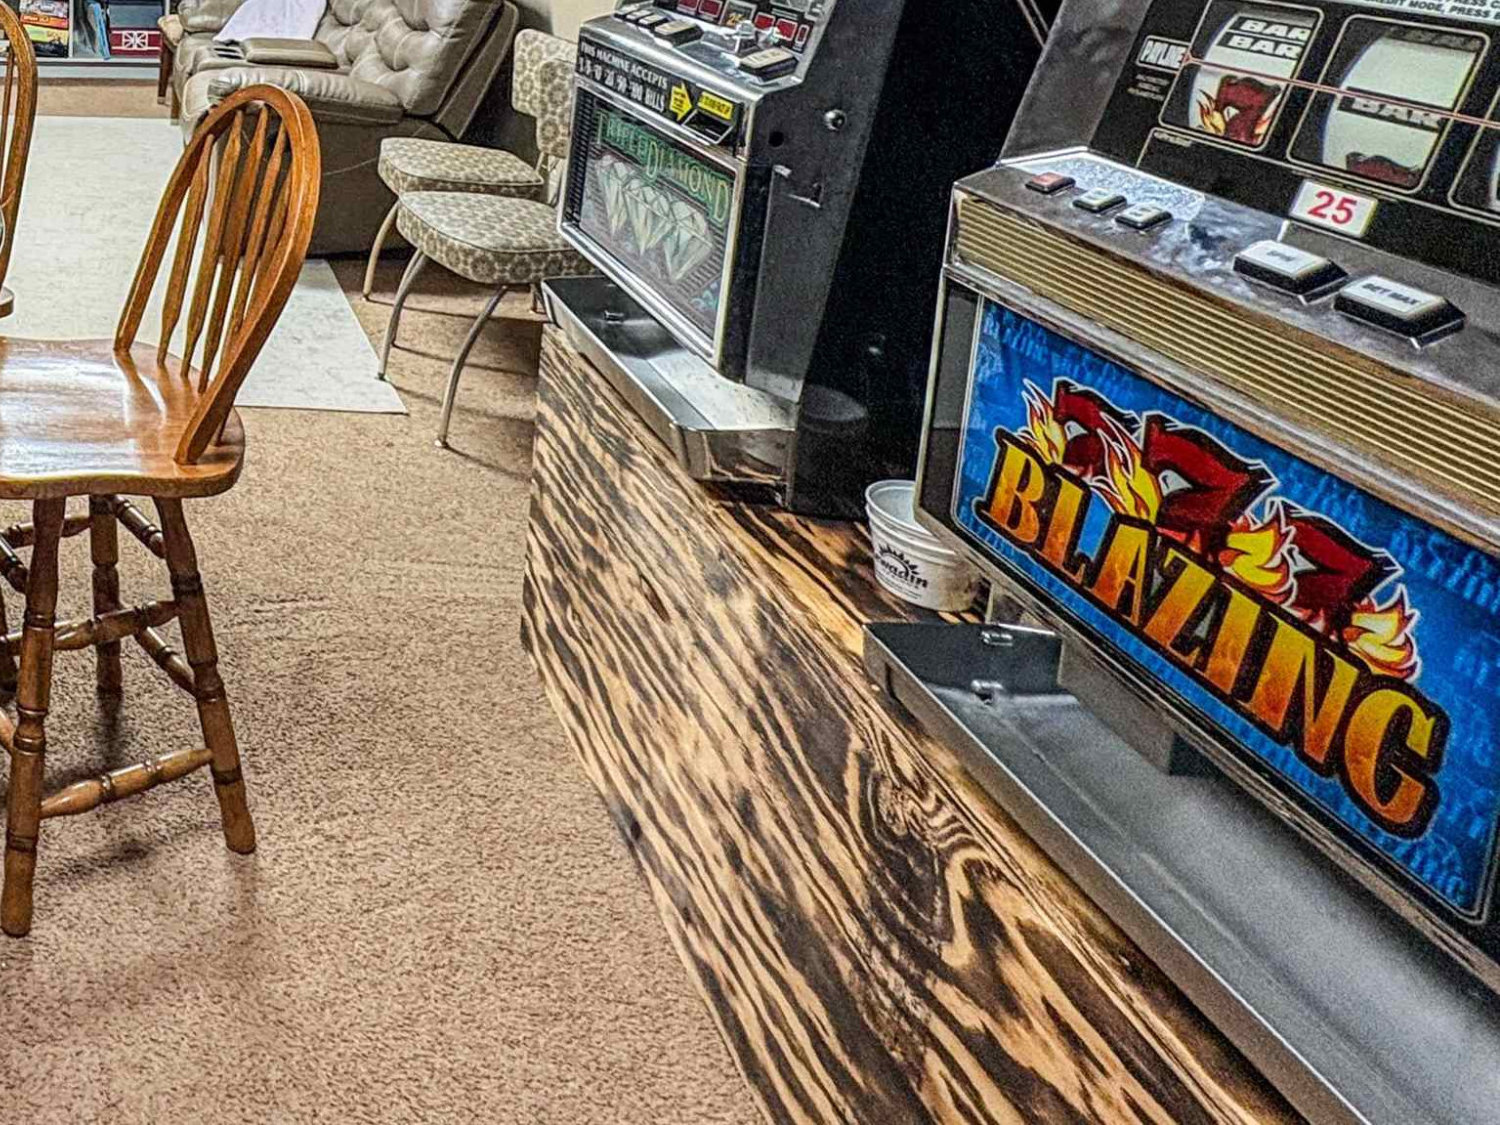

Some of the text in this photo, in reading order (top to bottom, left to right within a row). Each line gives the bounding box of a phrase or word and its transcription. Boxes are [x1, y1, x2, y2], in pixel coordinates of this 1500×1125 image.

[1450, 5, 1490, 19] PRESS
[1228, 35, 1302, 59] BAR
[597, 46, 631, 73] MACHINE
[631, 63, 668, 89] ACCEPTS
[594, 108, 730, 223] TRIPLE DIAMOND
[1307, 191, 1358, 224] 25
[1362, 283, 1422, 305] BET MAX
[980, 438, 1438, 827] BLAZING
